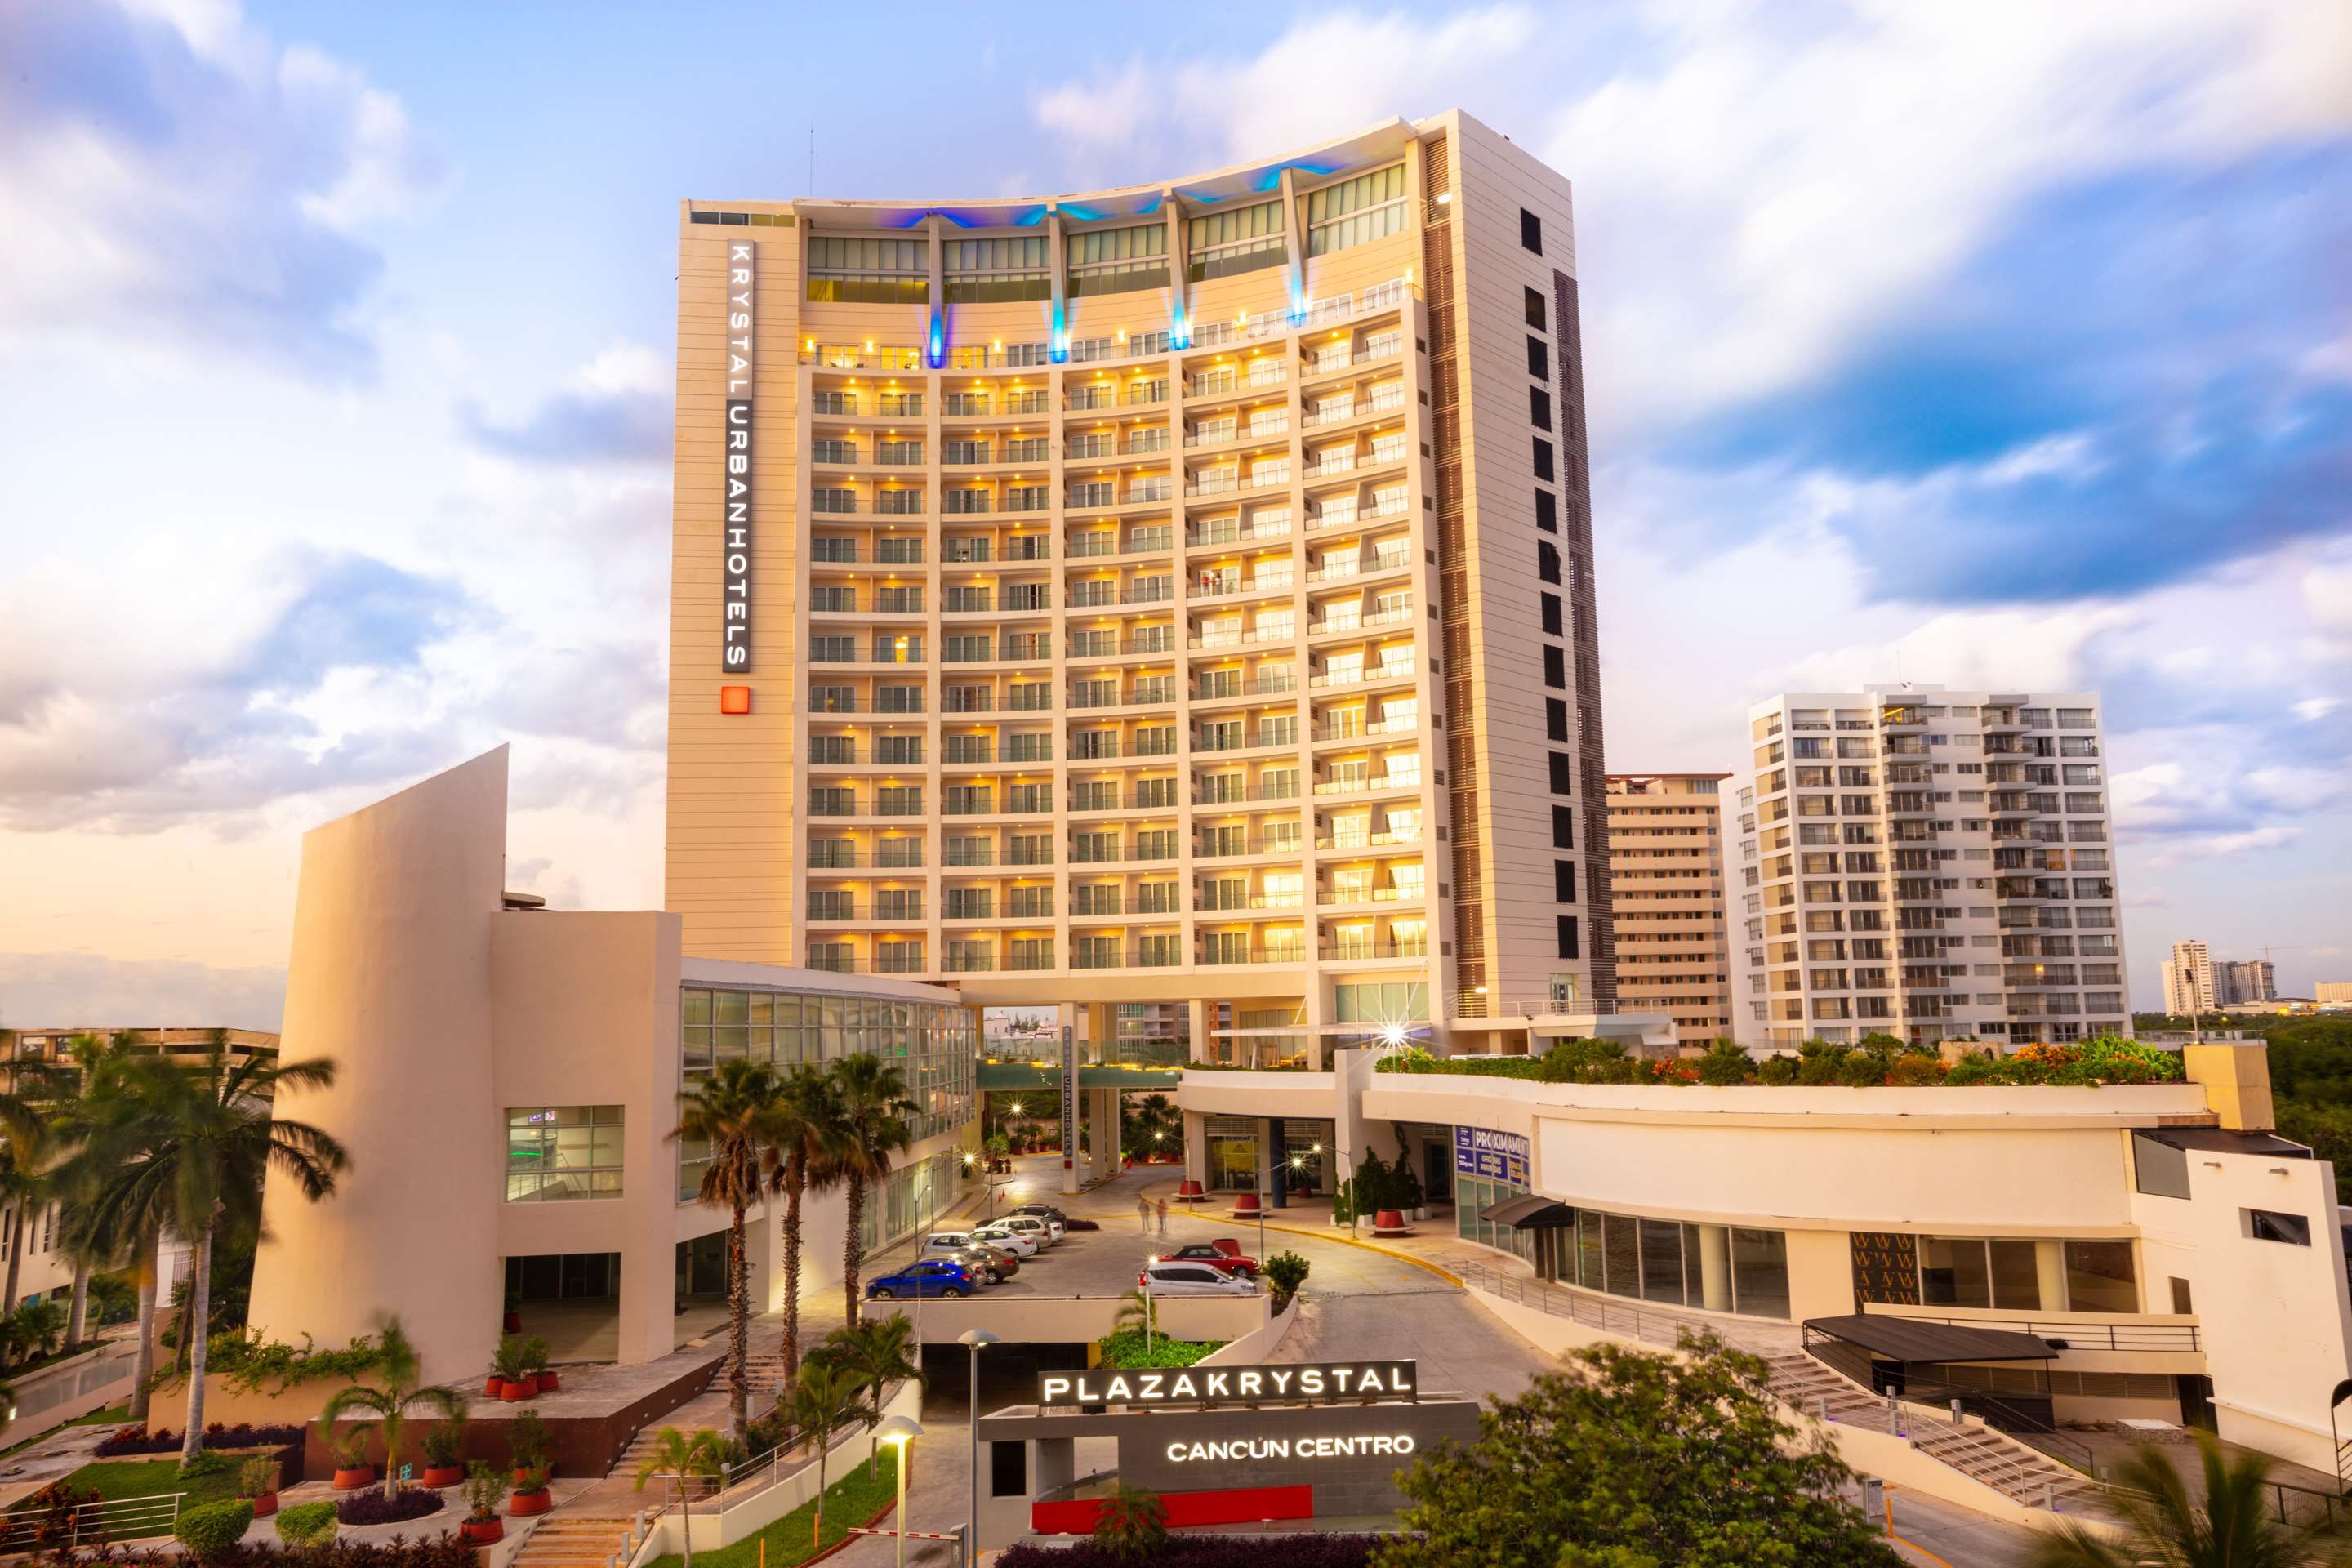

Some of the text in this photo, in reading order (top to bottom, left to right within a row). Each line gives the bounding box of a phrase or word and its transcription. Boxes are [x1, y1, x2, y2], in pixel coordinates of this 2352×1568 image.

[729, 245, 751, 393] KRYSTAL
[1167, 1435, 1414, 1462] CANCÚN CENTRO
